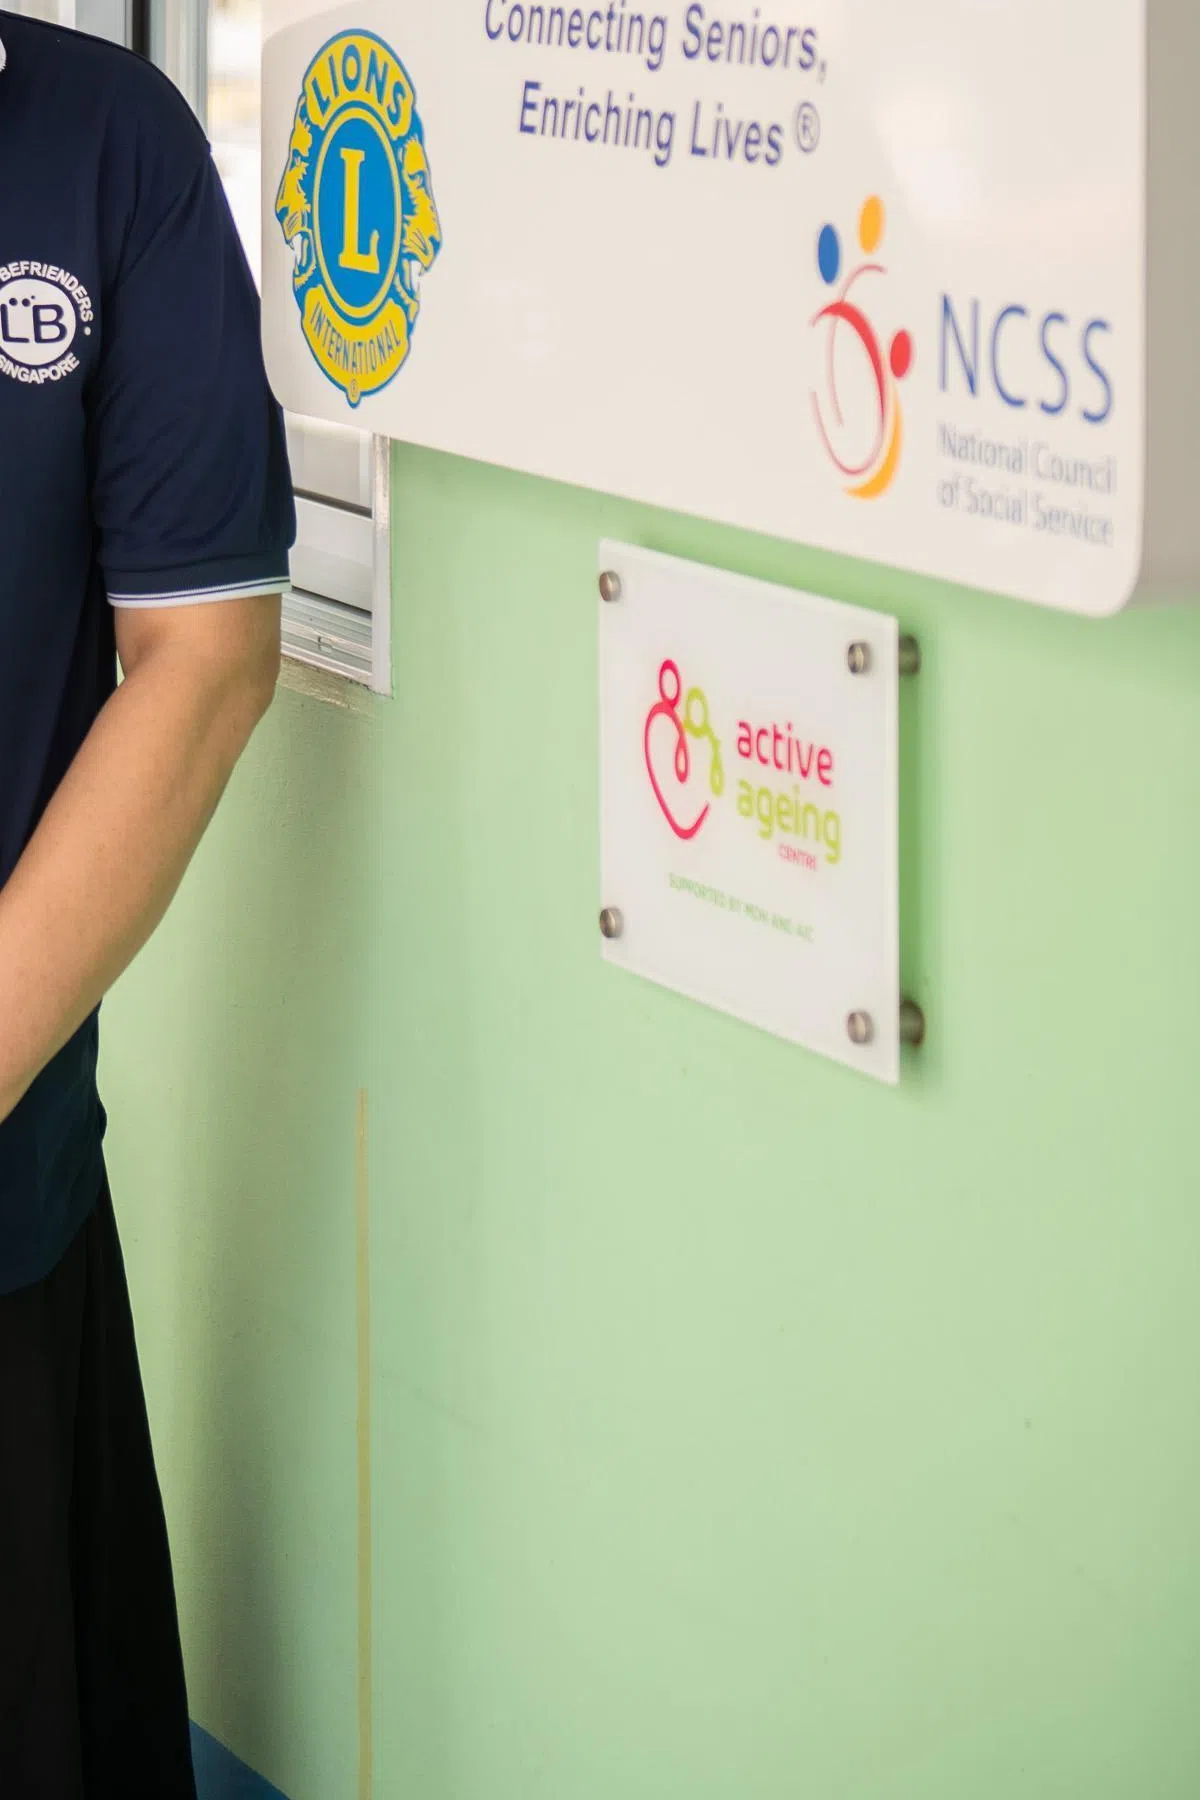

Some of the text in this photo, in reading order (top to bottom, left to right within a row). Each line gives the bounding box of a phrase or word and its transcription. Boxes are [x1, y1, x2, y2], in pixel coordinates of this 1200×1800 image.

[311, 43, 407, 129] LIONS
[682, 2, 827, 86] Seniors,
[519, 79, 676, 167] Enriching
[689, 99, 783, 166] Lives
[338, 146, 380, 275] L
[309, 300, 402, 377] INTERNATIONAL
[940, 291, 1115, 425] NCSS
[937, 421, 1115, 496] National Council
[937, 472, 1114, 546] of Social Service
[736, 719, 834, 786] active
[736, 778, 842, 865] ageing
